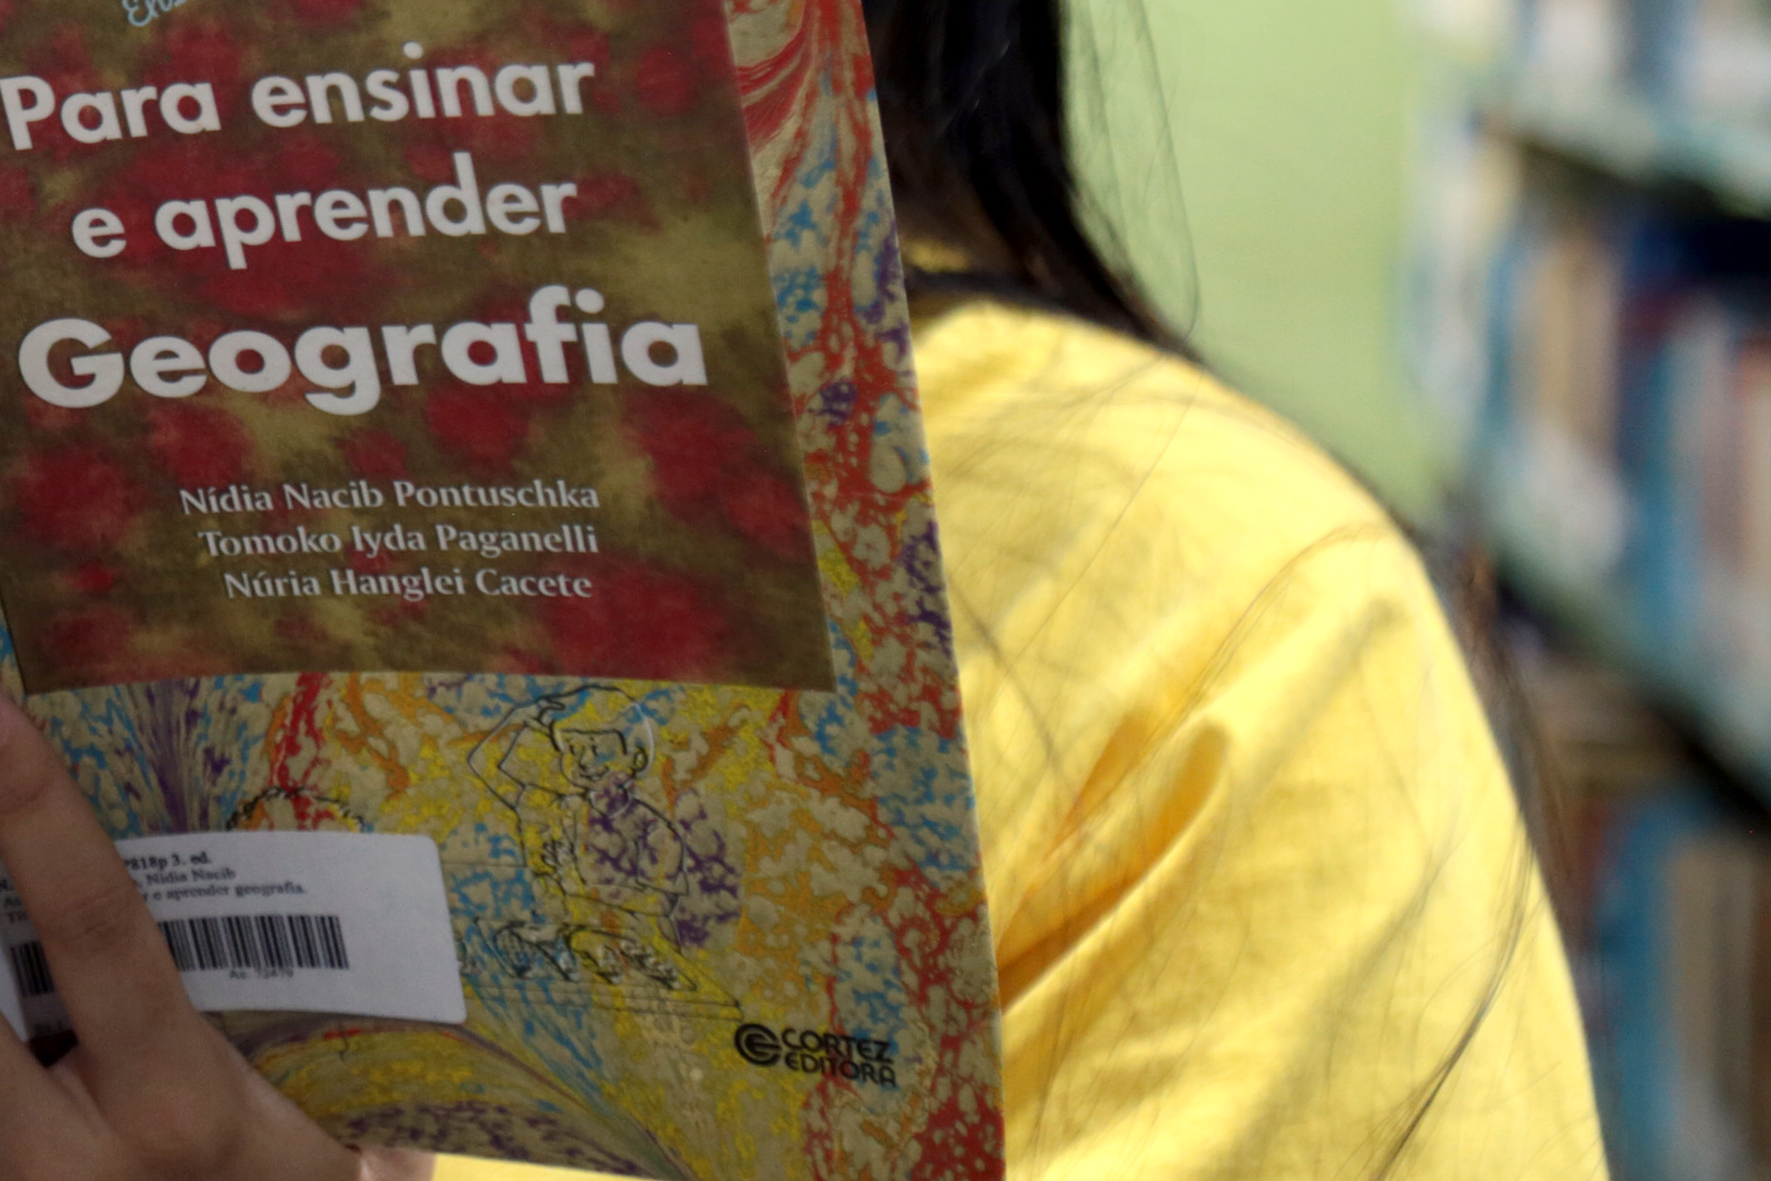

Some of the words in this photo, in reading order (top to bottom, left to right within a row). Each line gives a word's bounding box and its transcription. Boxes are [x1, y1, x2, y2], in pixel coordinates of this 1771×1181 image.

[250, 41, 595, 128] ensinar
[71, 205, 126, 258] e
[154, 152, 578, 270] aprender
[19, 285, 708, 415] Geografia
[179, 484, 273, 517] Nídia
[282, 481, 383, 510] Nacib
[393, 479, 600, 510] Pontuschka
[198, 525, 342, 558] Tomoko
[352, 524, 426, 562] Iyda
[435, 522, 599, 560] Paganelli
[224, 569, 322, 601] Núria
[328, 567, 466, 602] Hanglei
[475, 569, 592, 600] Cacete
[781, 1027, 894, 1065] CORTEZ
[785, 1052, 897, 1087] EDITORA
